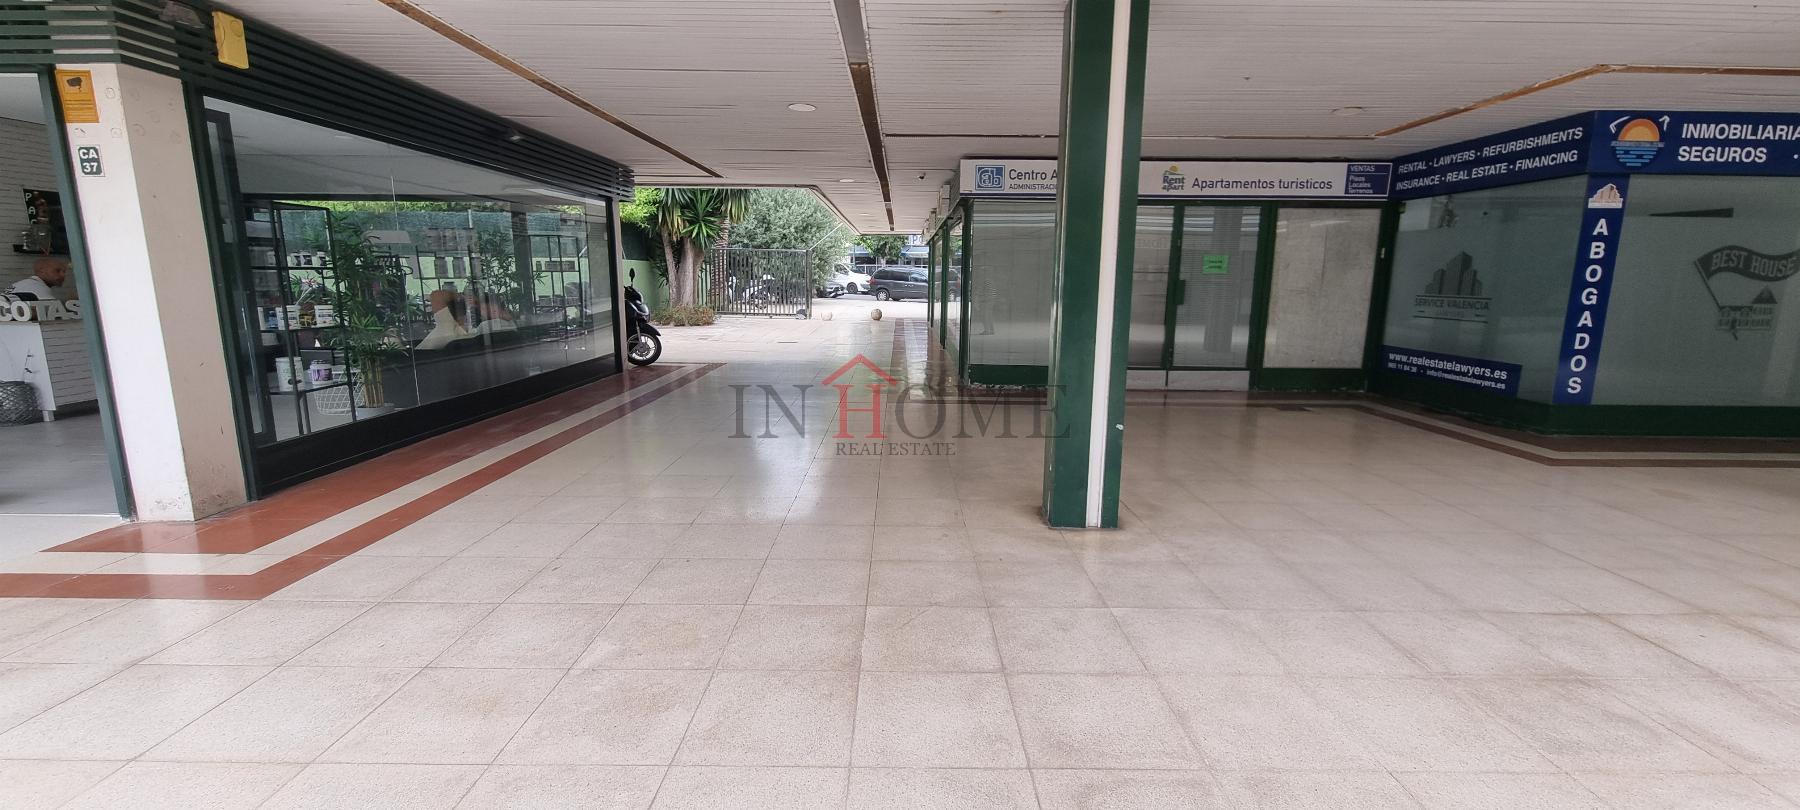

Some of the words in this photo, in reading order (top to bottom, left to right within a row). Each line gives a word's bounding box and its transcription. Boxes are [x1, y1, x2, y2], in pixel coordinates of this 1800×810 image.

[1681, 123, 1800, 140] INMOBILIARIA
[80, 149, 98, 159] CA
[1398, 162, 1427, 174] RENTAL
[1433, 149, 1475, 167] LAWYERS
[1482, 127, 1583, 158] REFURBISHMENTS
[1677, 145, 1767, 163] SEGUROS
[83, 162, 97, 173] 37
[1009, 169, 1047, 180] Centro
[1396, 174, 1440, 191] INSURANCE
[1446, 171, 1470, 183] REAL
[1471, 162, 1508, 179] ESTATE
[1515, 150, 1578, 171] FINANCING
[1163, 175, 1185, 184] Rent
[1192, 177, 1275, 191] Apartamentos
[1162, 184, 1184, 192] apart
[1712, 250, 1747, 270] BEST
[1751, 255, 1796, 278] HOUSE
[1415, 297, 1444, 307] SERVICE
[1447, 300, 1489, 310] VALENCIA
[1567, 218, 1609, 394] ABOGADOS
[1388, 352, 1508, 380] www.realestatelawyers.es
